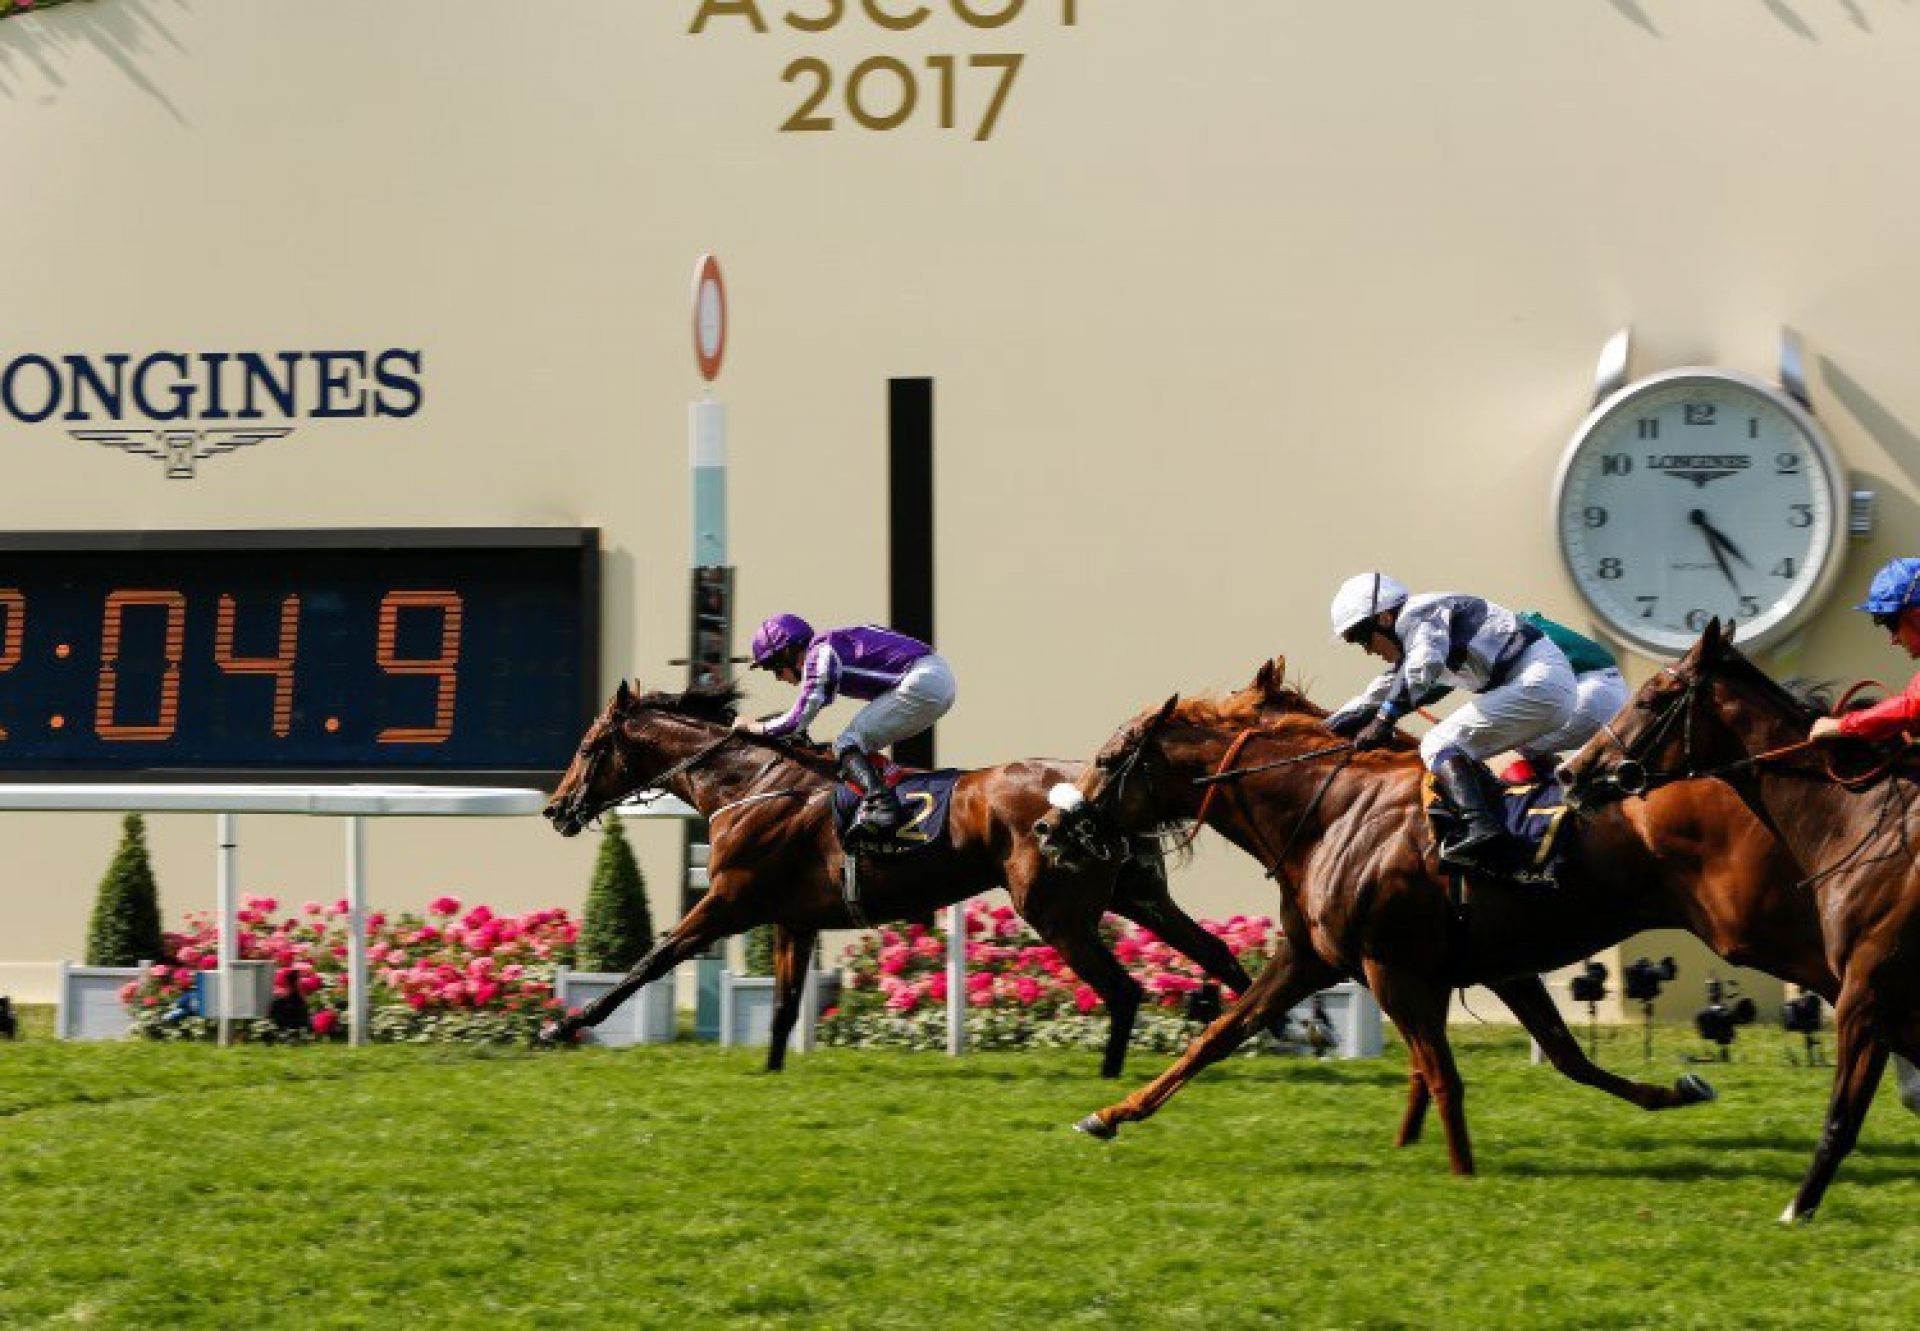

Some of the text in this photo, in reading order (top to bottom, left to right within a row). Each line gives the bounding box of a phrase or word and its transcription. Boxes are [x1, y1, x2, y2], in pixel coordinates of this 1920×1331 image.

[779, 54, 1025, 142] 2017
[1684, 403, 1717, 426] 12
[1638, 417, 1659, 440] 11
[1748, 417, 1759, 439] 1
[1602, 454, 1633, 477] 10
[1774, 452, 1799, 475] 2
[1584, 505, 1609, 528] 9
[1786, 504, 1814, 528] 3
[1597, 556, 1624, 580] 8
[1769, 556, 1796, 580] 4
[1635, 595, 1659, 618] 7
[1739, 595, 1760, 618] 5
[0, 588, 463, 744] :04.9
[896, 792, 934, 841] 2
[1527, 805, 1570, 865] 7
